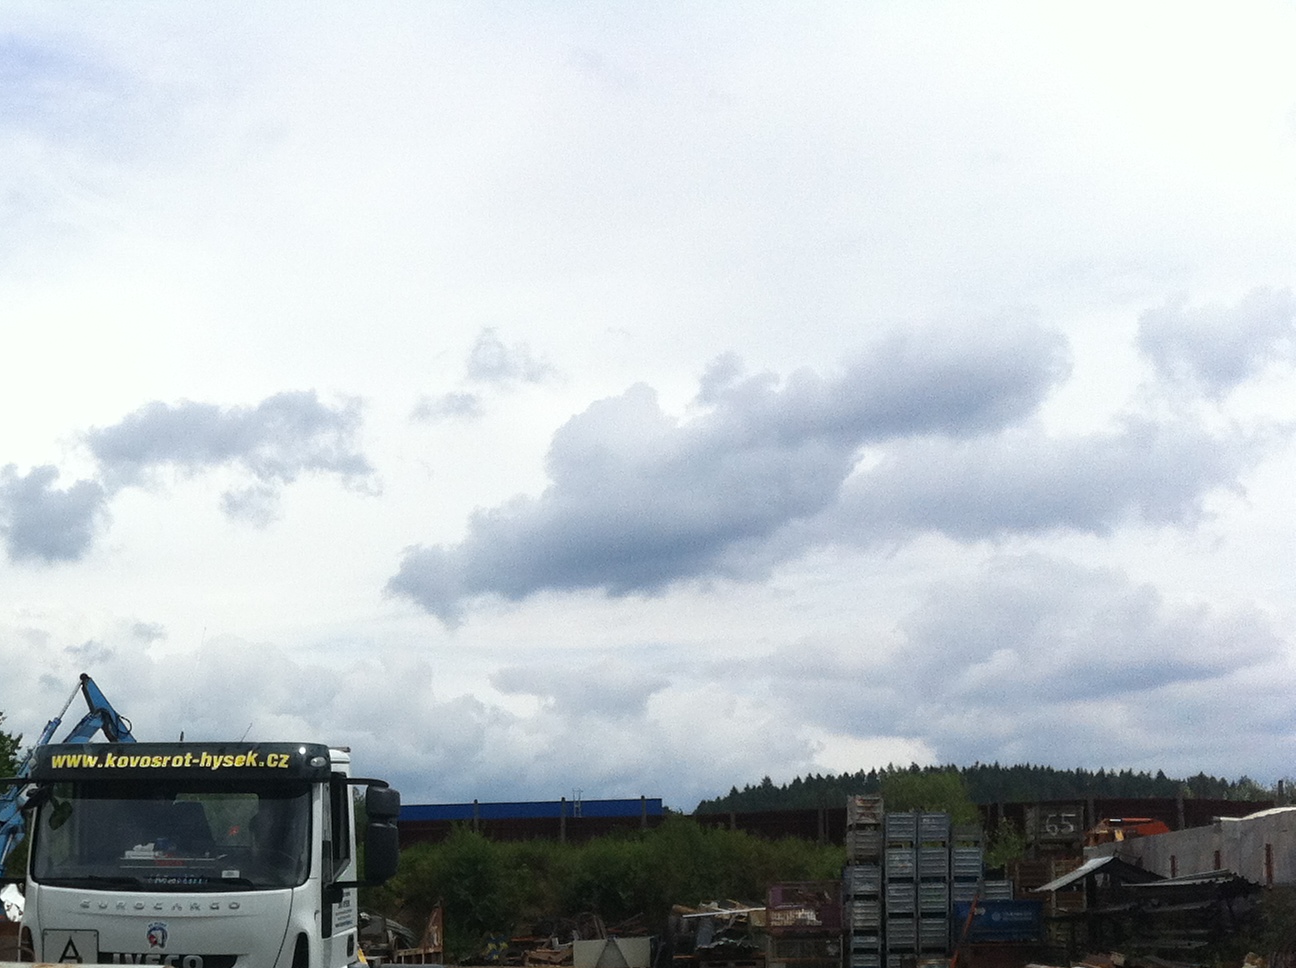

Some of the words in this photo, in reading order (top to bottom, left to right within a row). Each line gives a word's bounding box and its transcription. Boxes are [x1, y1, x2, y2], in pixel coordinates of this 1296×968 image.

[52, 751, 290, 770] www.kovosrot-hysek.cz
[1046, 813, 1076, 836] 65
[80, 900, 240, 912] EUROCARGO
[59, 935, 83, 964] A
